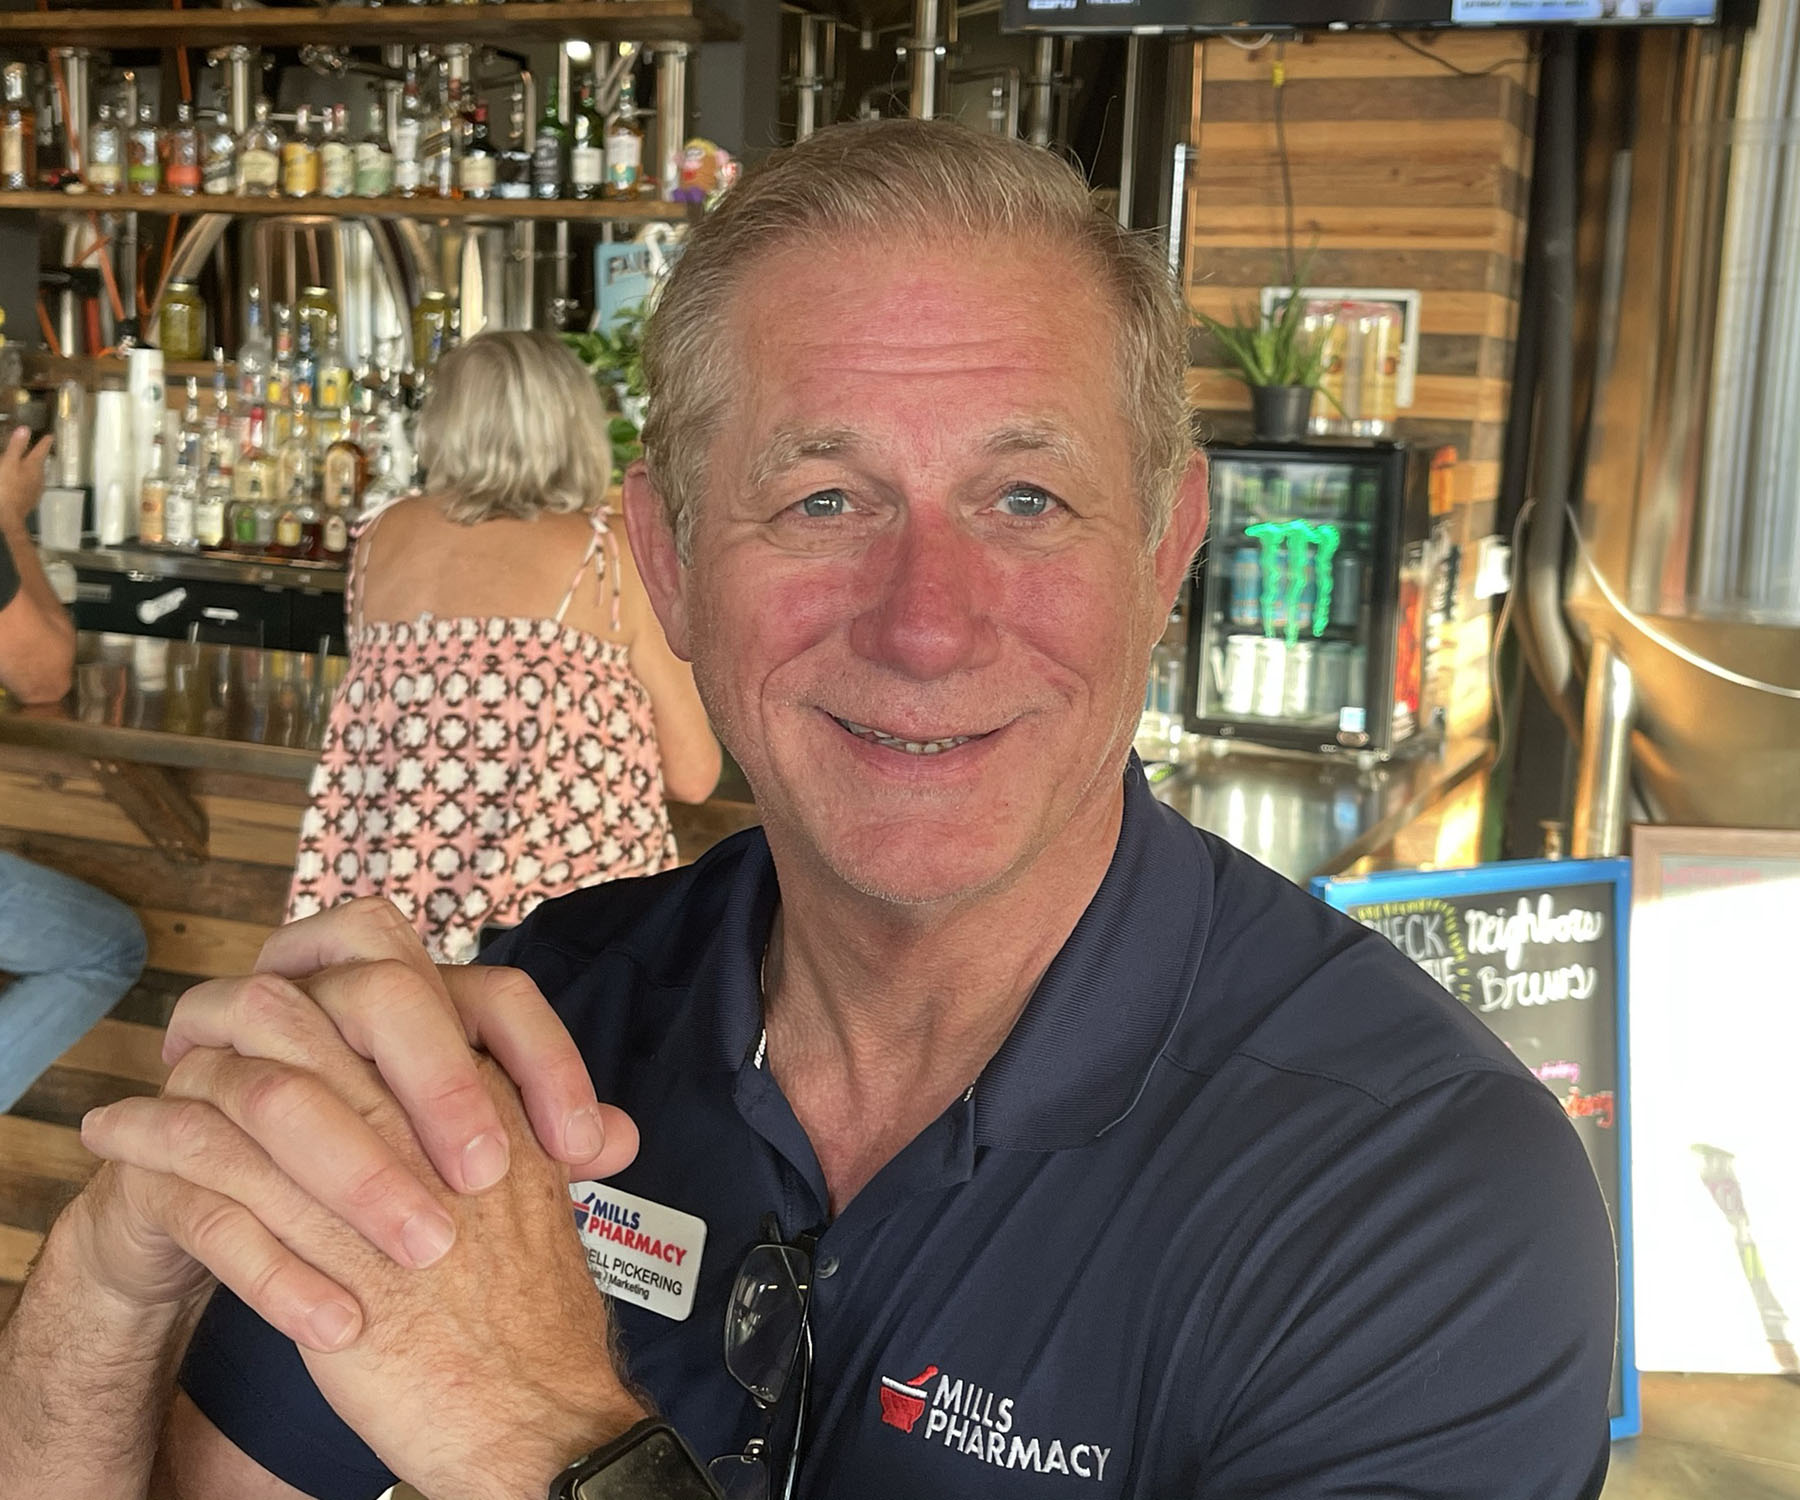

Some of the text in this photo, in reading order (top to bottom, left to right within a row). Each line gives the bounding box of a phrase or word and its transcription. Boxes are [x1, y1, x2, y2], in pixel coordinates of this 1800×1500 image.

[1477, 962, 1598, 1012] Brews
[592, 1198, 641, 1230] MILLS
[588, 1215, 688, 1266] PHARMACY
[586, 1247, 609, 1269] ELL
[612, 1257, 683, 1296] PICKERING
[608, 1273, 650, 1301] Marketing
[932, 1374, 1014, 1434] MILLS
[924, 1408, 1112, 1481] PHARMACY
